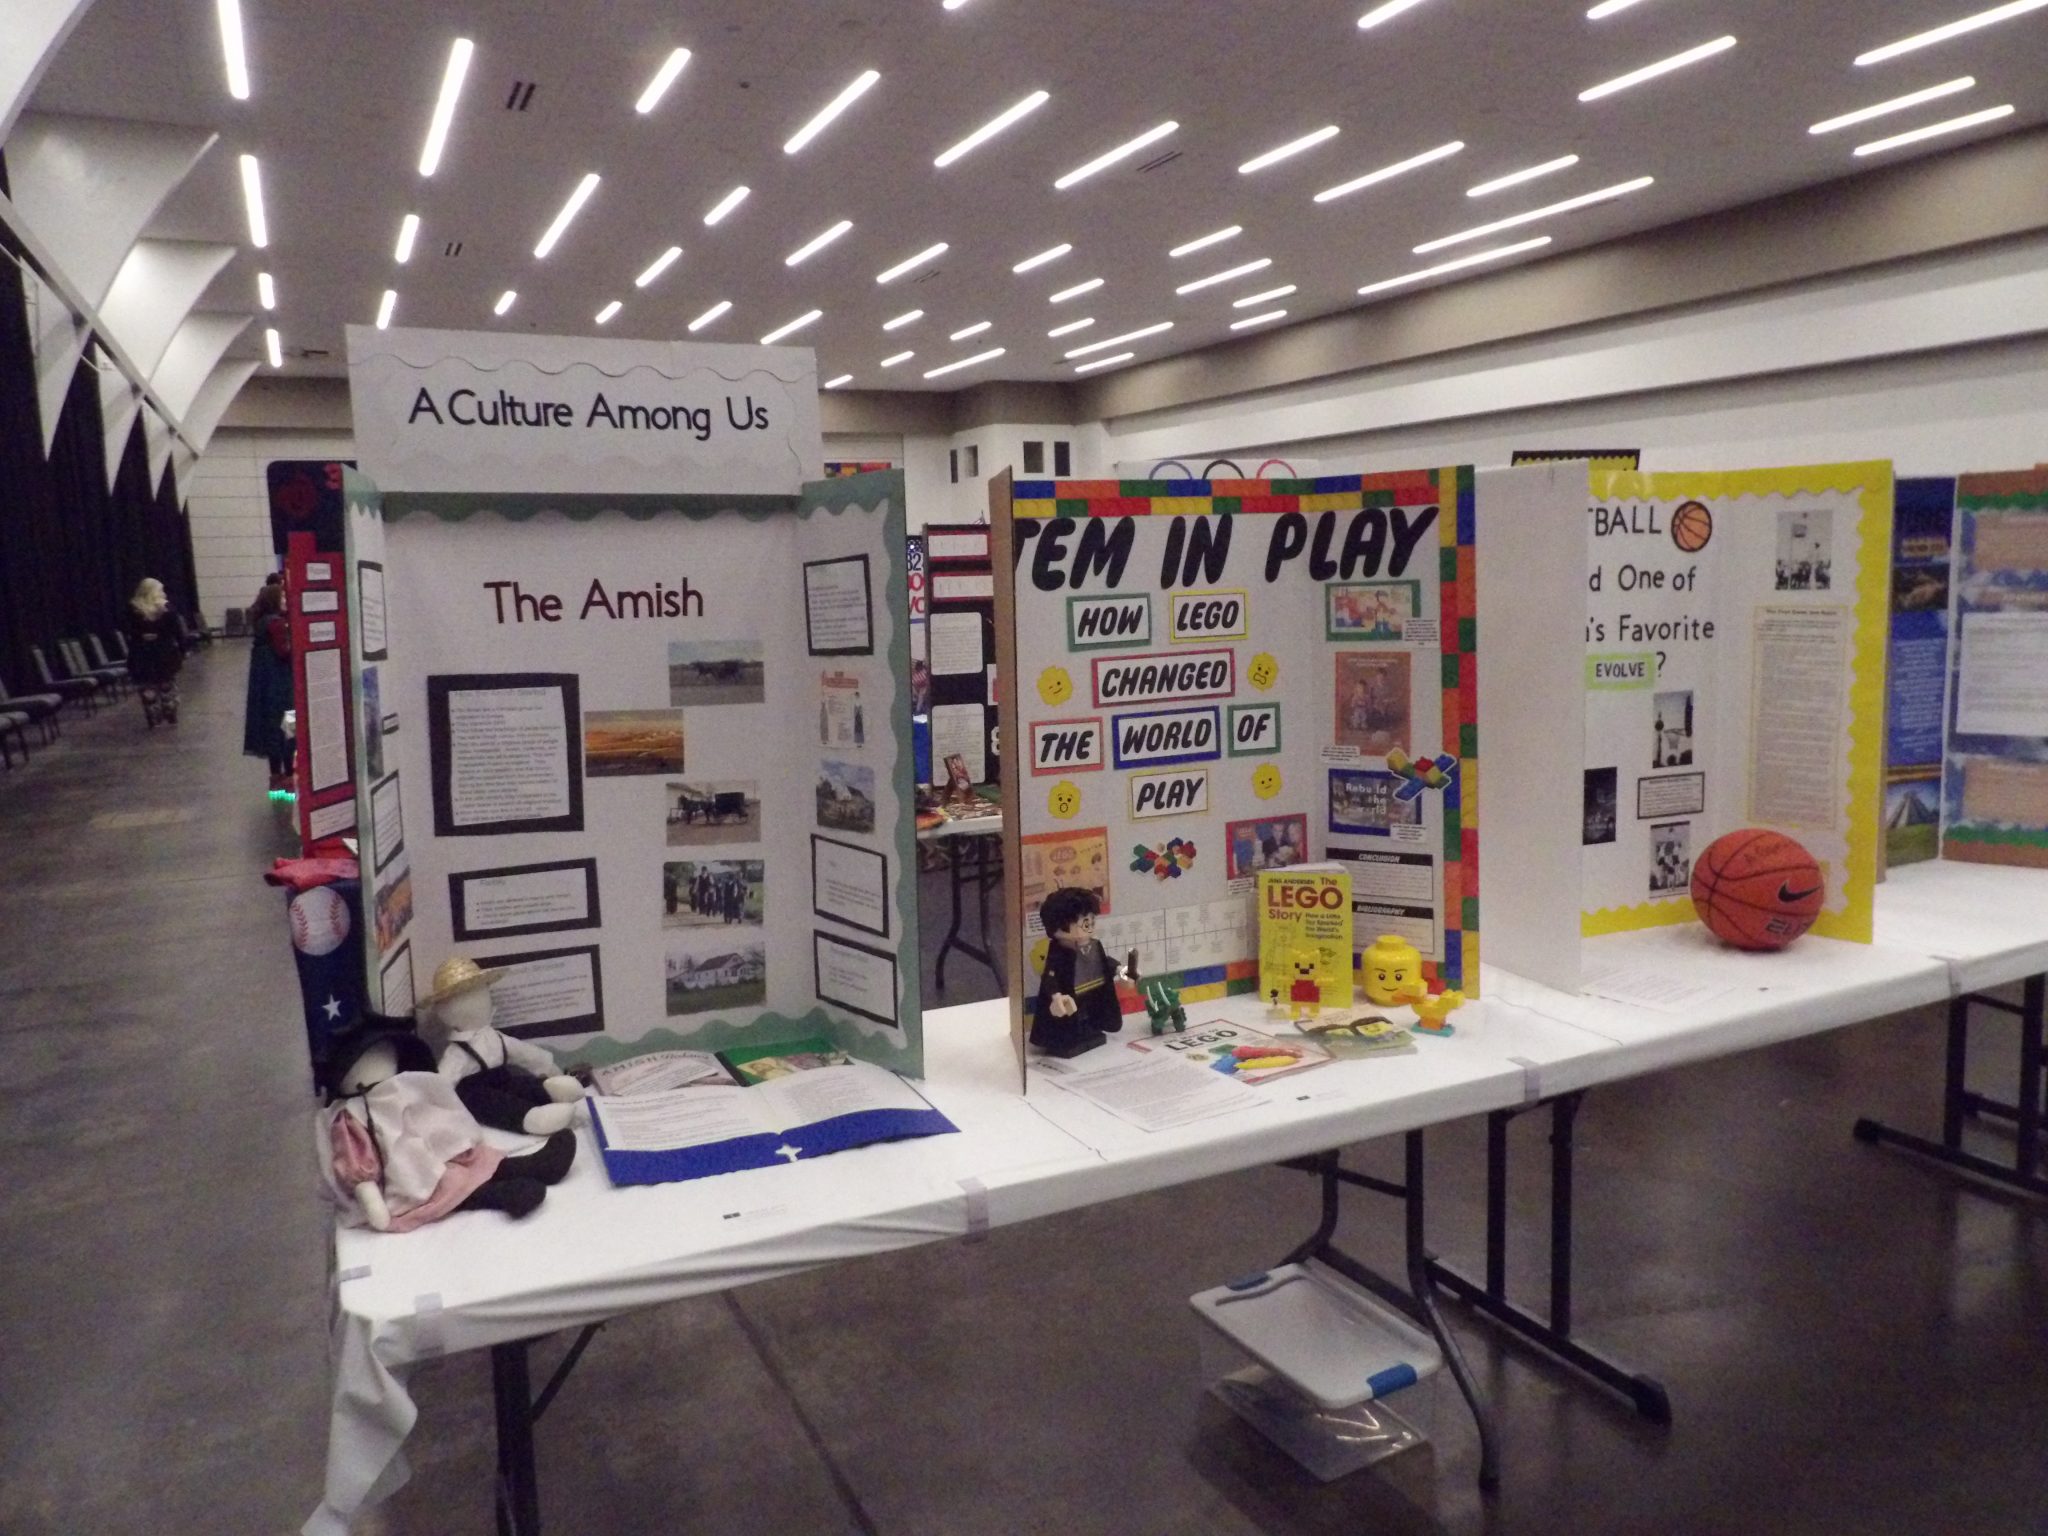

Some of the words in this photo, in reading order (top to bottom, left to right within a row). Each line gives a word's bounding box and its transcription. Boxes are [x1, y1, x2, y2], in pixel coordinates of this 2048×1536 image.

[408, 387, 444, 425] A
[448, 389, 574, 428] Culture
[586, 392, 712, 441] Among
[726, 396, 769, 431] Us
[1587, 505, 1662, 537] BALL
[1160, 512, 1234, 590] IN
[1264, 505, 1440, 584] PLAY
[1617, 564, 1665, 592] One
[1672, 565, 1697, 591] of
[483, 581, 563, 624] The
[579, 577, 704, 620] Amish
[1077, 604, 1144, 638] HOW
[1176, 600, 1240, 632] LEGO
[1618, 614, 1715, 642] Favorite
[1101, 660, 1228, 698] CHANGED
[1595, 661, 1646, 679] EVOLVE
[1040, 730, 1095, 763] THE
[1122, 718, 1213, 755] WORLD
[1236, 713, 1271, 743] OF
[1135, 776, 1205, 812] PLAY
[1320, 876, 1338, 886] The
[1267, 885, 1344, 910] LEGO
[1268, 908, 1303, 923] Story
[1164, 1029, 1239, 1051] LEGO
